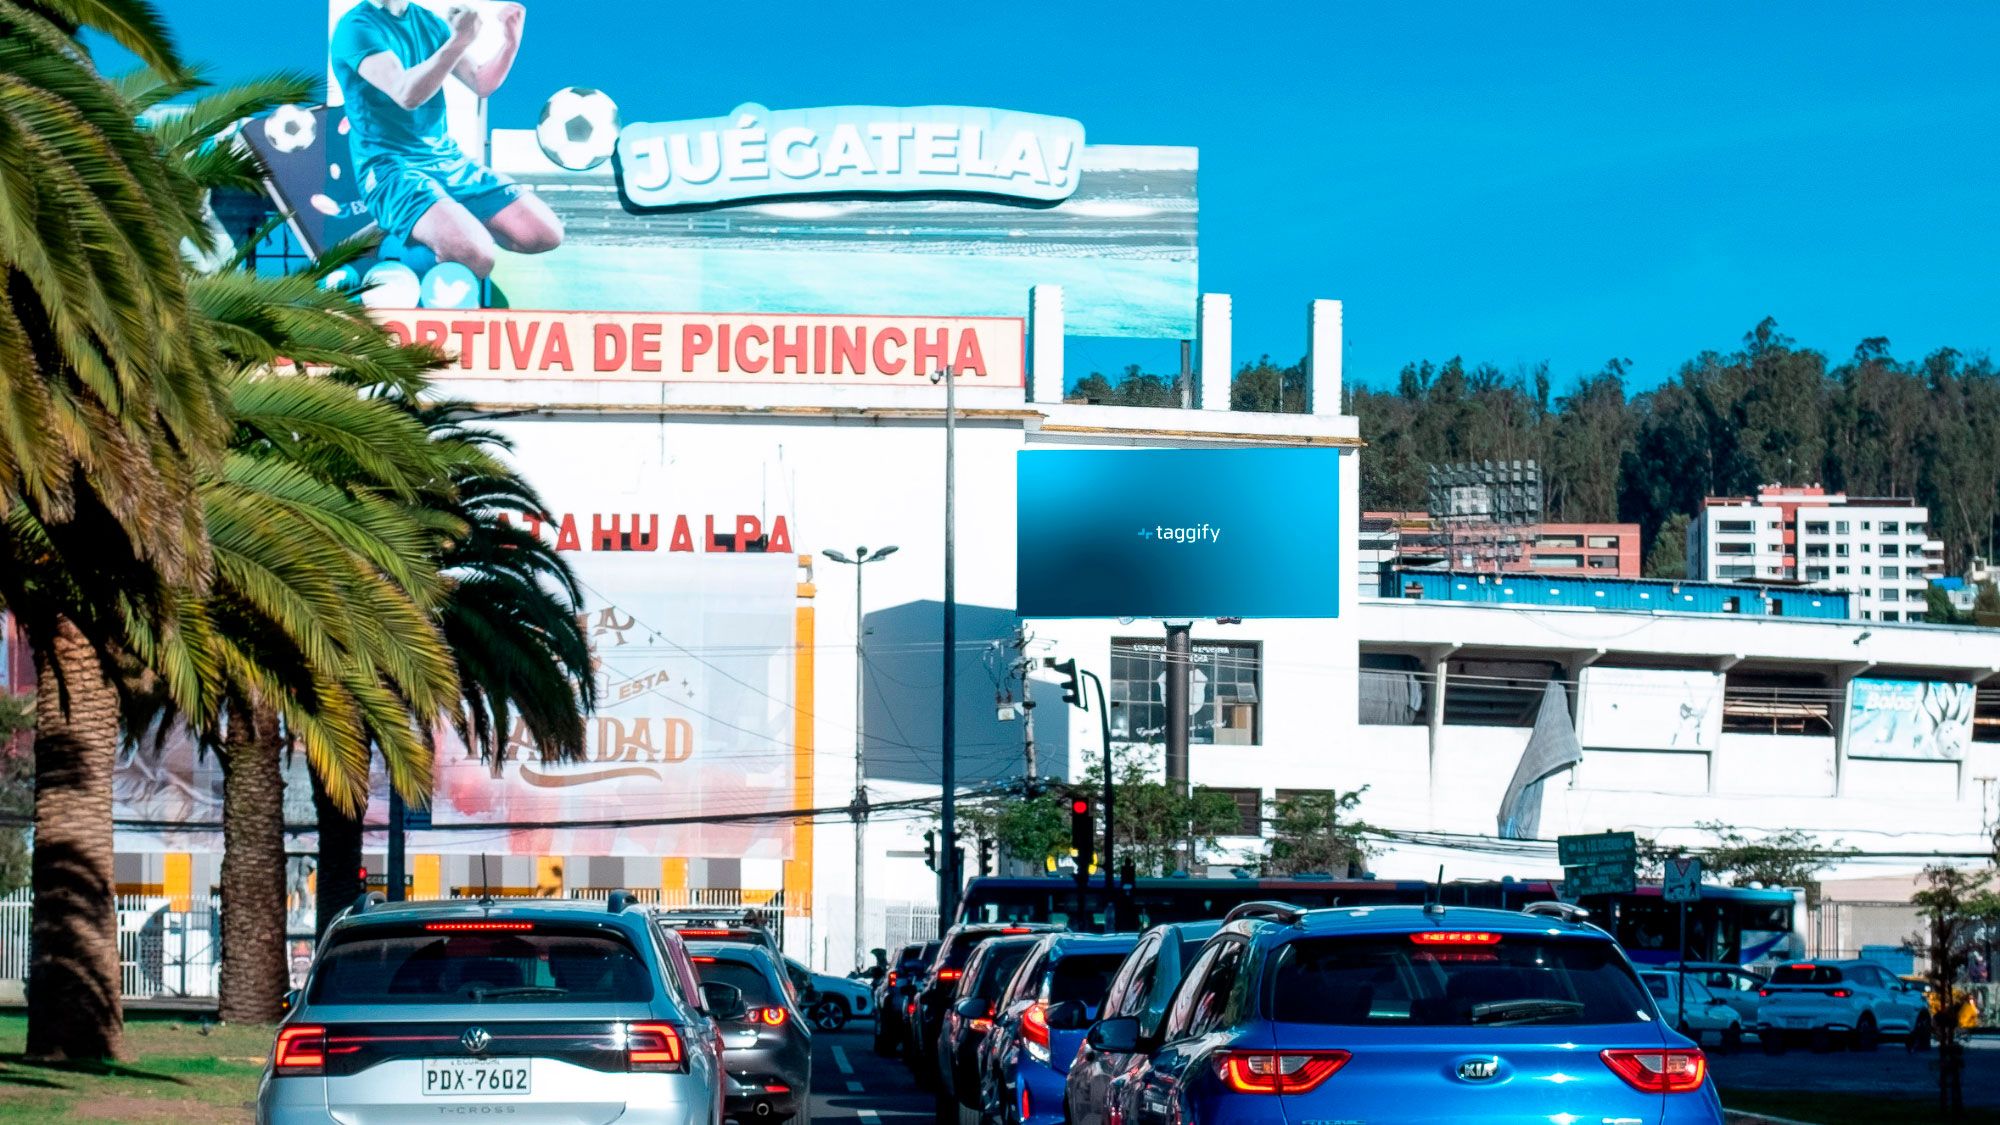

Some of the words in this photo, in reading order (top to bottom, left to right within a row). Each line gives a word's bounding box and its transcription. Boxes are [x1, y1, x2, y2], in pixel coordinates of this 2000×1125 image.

[630, 113, 1075, 190] JUÉGATELA!
[593, 322, 663, 373] DE
[681, 323, 988, 377] PICHINCHA
[1156, 523, 1220, 543] taggify
[618, 669, 671, 700] ESTA
[427, 1069, 527, 1090] PDX-7602
[1464, 1062, 1495, 1077] KIA
[439, 1106, 516, 1114] T-CROSS
